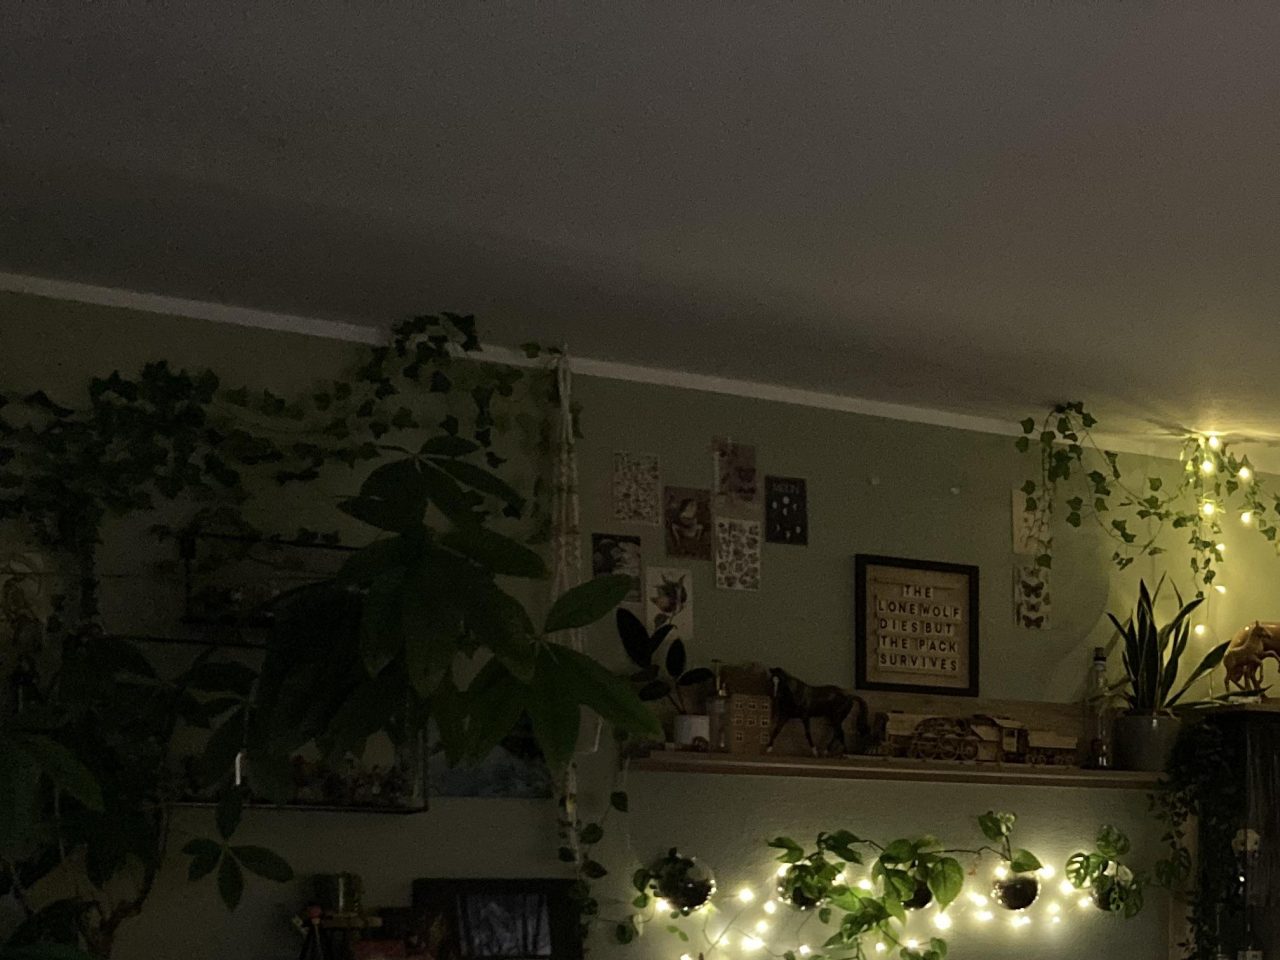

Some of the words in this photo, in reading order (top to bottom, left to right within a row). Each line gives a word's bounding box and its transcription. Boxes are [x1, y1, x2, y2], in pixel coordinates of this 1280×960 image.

[904, 585, 932, 598] THE
[878, 601, 916, 615] LONE
[921, 604, 960, 618] WOLF
[880, 618, 918, 633] DIES
[925, 623, 952, 634] BUT
[881, 636, 909, 649] THE
[918, 640, 957, 652] PACK
[880, 654, 958, 671] SURVIVES
